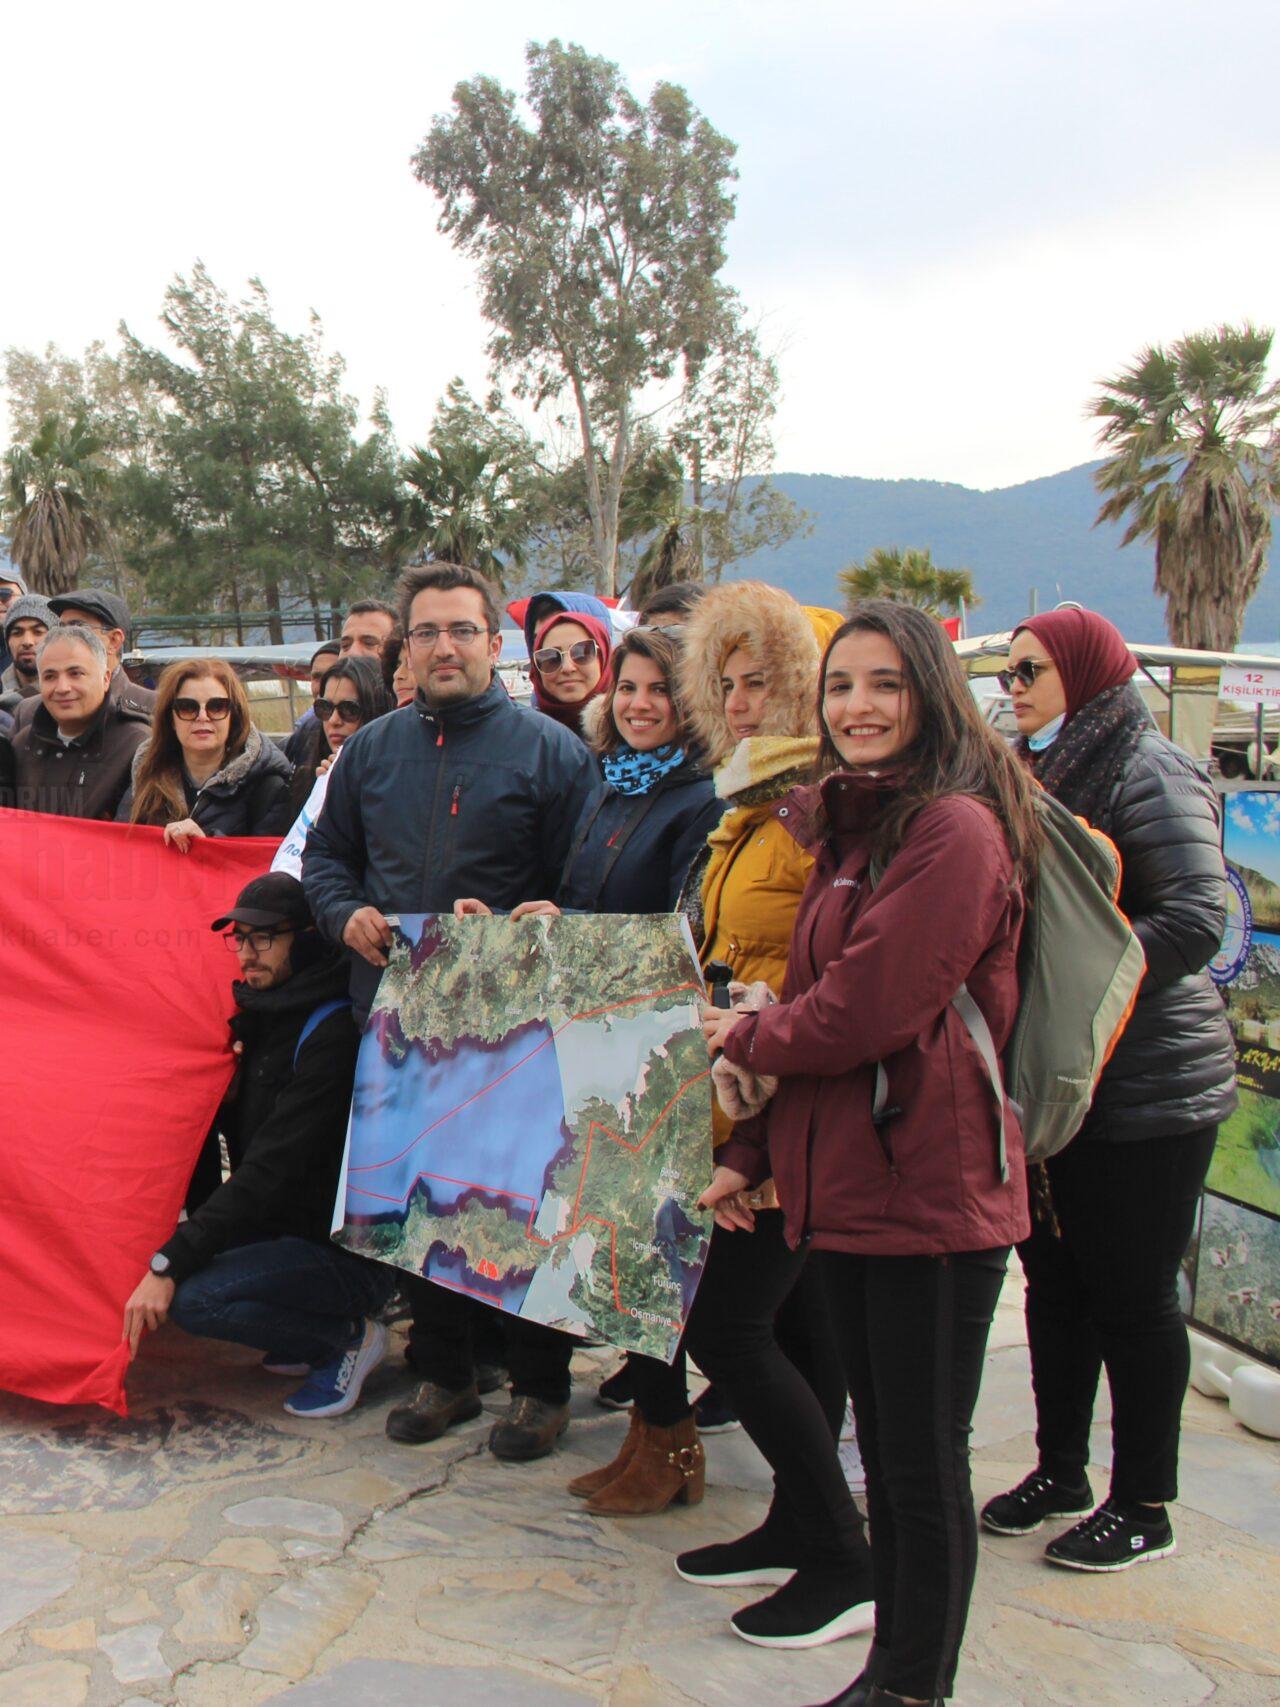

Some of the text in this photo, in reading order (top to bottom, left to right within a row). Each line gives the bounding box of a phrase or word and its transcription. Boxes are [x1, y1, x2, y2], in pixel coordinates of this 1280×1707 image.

[1244, 673, 1263, 683] 12
[652, 1275, 682, 1292] Turunç
[630, 1307, 672, 1327] Osmaniye
[334, 1349, 358, 1394] HOKA
